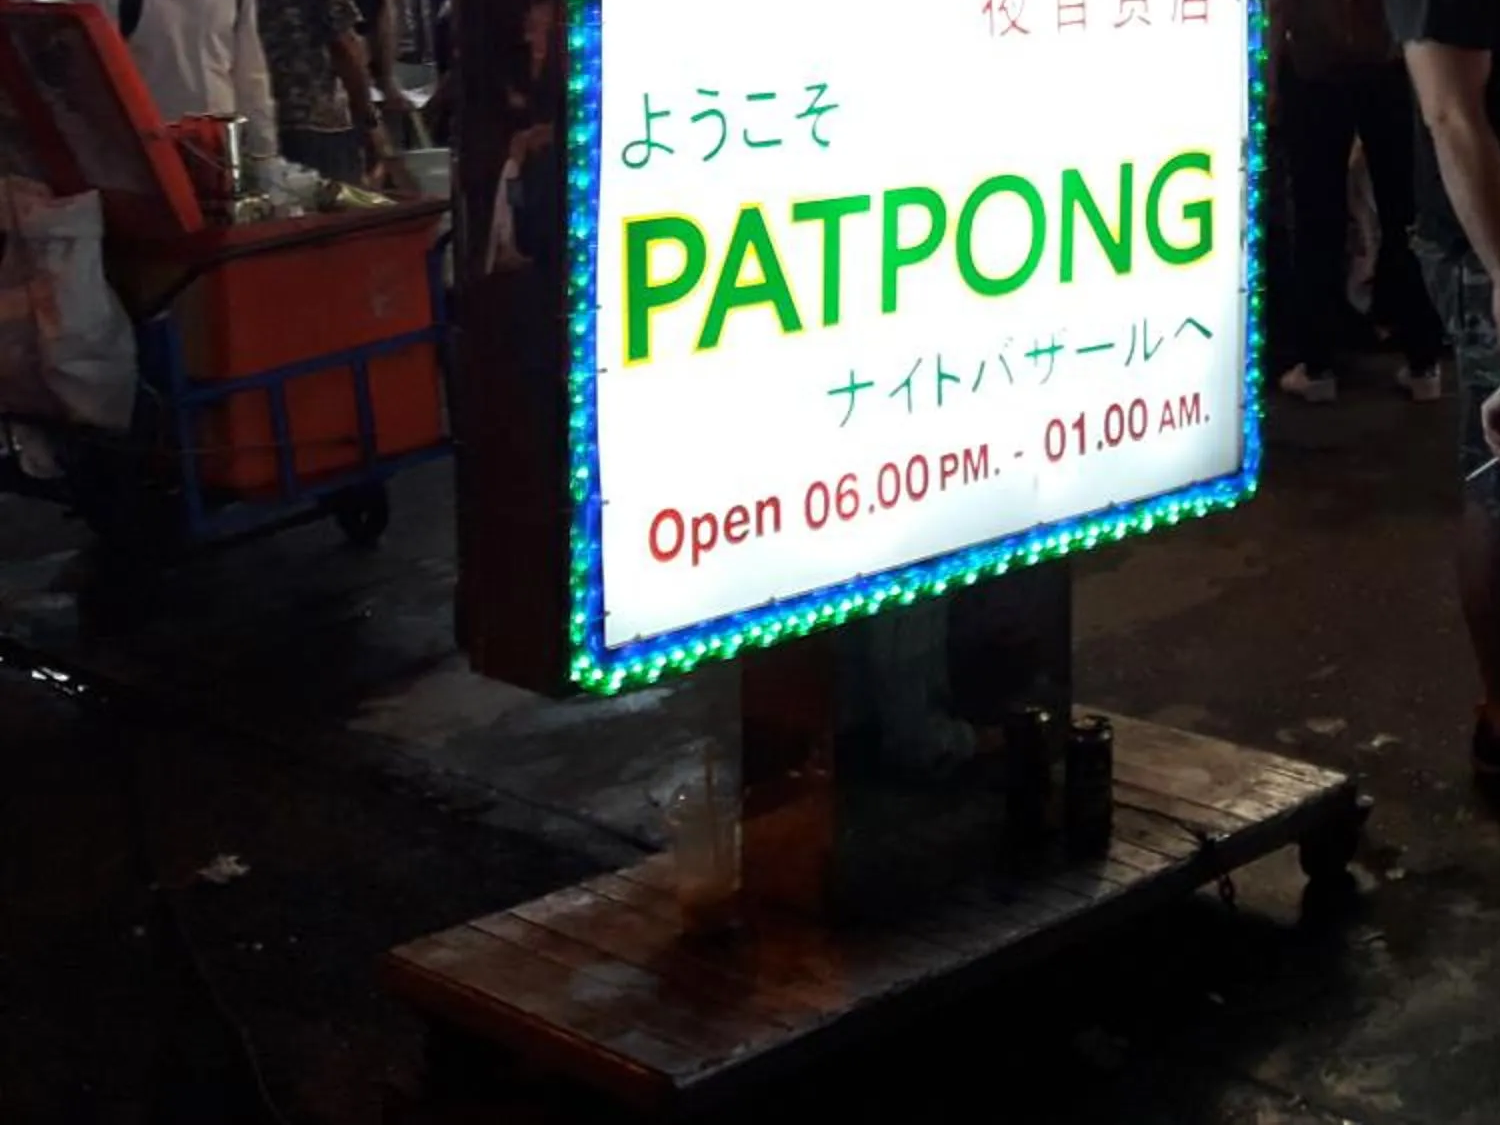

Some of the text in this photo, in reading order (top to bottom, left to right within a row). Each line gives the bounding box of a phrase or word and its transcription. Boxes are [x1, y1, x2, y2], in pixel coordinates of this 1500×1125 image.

[620, 81, 841, 169] ようこそ
[622, 151, 1215, 365] PATPONG
[647, 494, 783, 566] Open
[803, 454, 931, 531] 06.00
[938, 443, 1001, 492] PM.
[1043, 398, 1149, 462] 01.00
[1157, 392, 1212, 434] AM.
